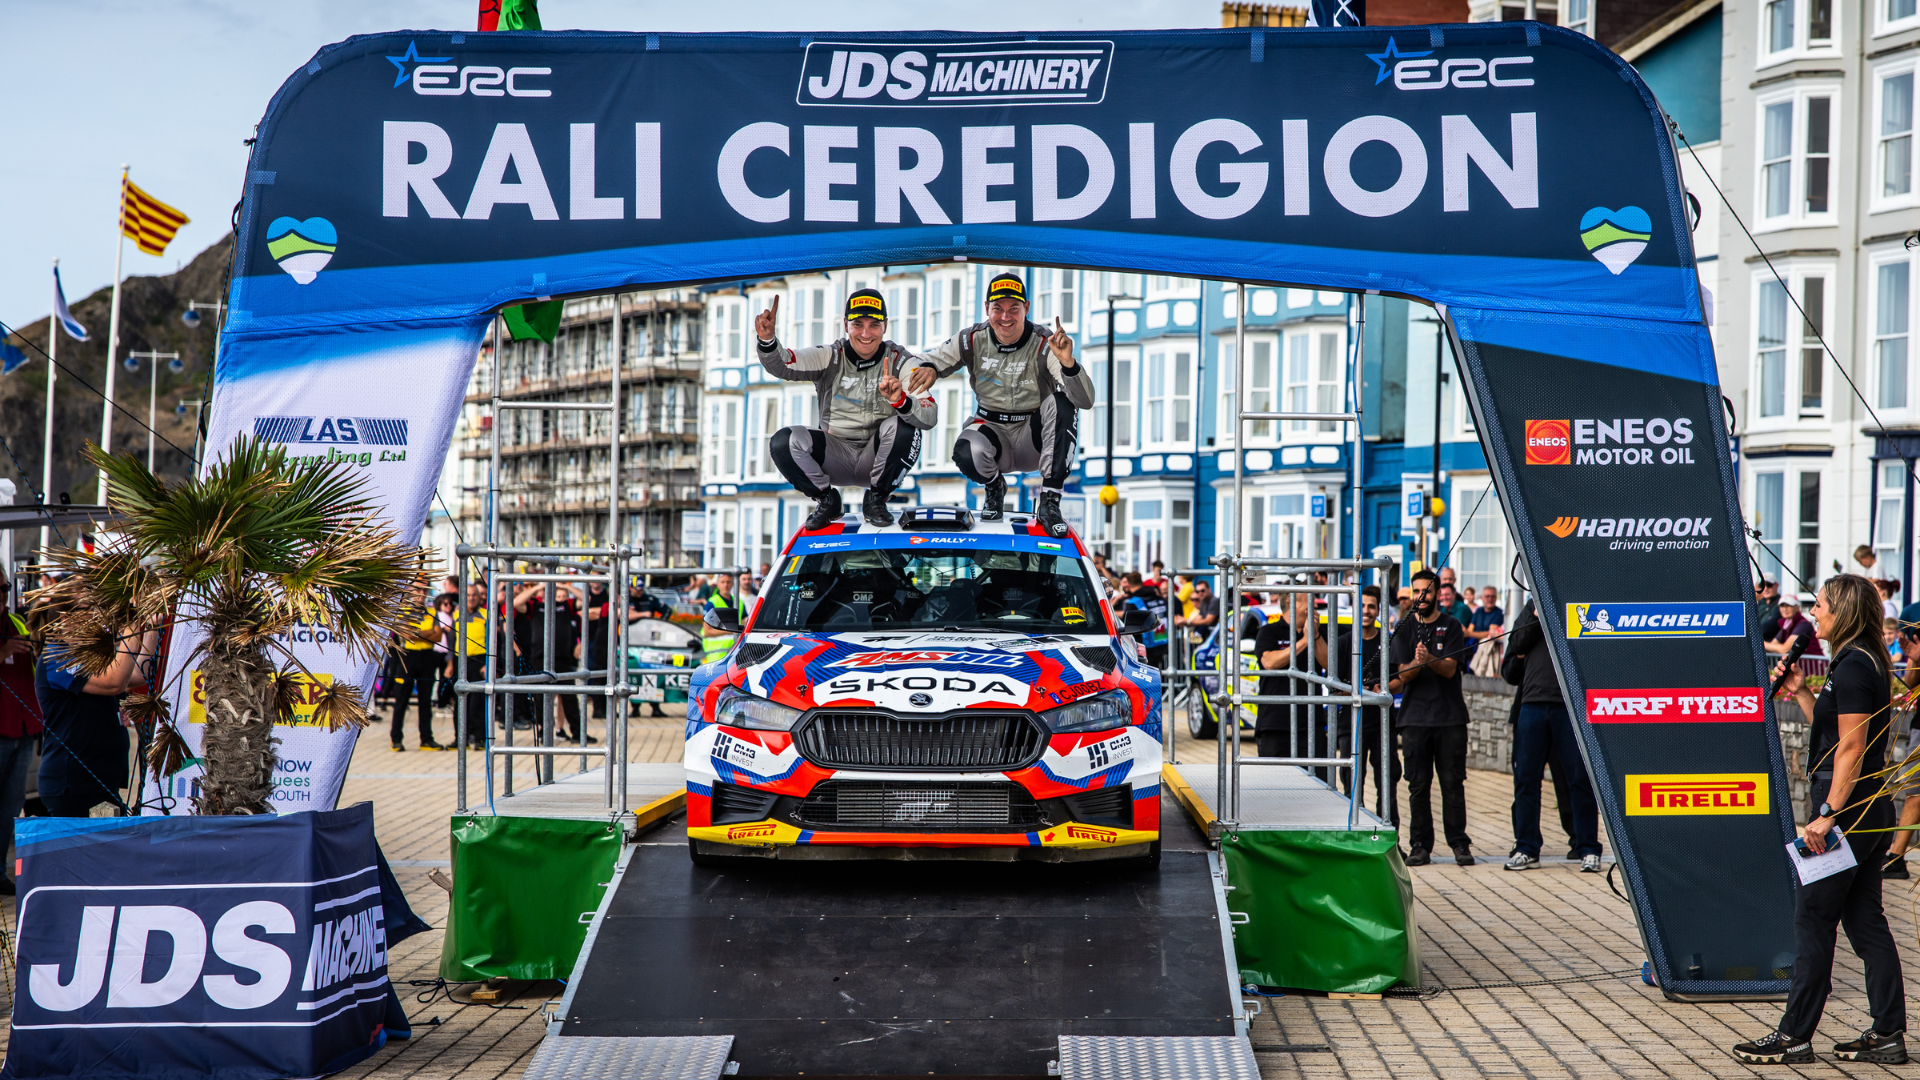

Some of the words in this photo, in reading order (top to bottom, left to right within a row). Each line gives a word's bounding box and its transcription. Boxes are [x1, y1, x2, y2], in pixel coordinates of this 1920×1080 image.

[413, 65, 552, 97] ERC
[808, 51, 928, 100] JDS
[929, 58, 1101, 93] MACHINERY
[1394, 56, 1535, 90] ERC
[382, 121, 661, 220] RALI
[717, 112, 1539, 225] CEREDIGION
[300, 418, 359, 442] LAS
[1574, 417, 1694, 445] ENEOS
[1528, 437, 1568, 447] ENEOS
[379, 450, 406, 462] Ltd
[1575, 448, 1654, 465] MOTOR
[1660, 447, 1695, 465] OIL
[1609, 538, 1653, 552] driving
[1656, 539, 1709, 550] emotion
[788, 556, 801, 574] 1
[853, 593, 874, 602] OMP
[1617, 614, 1730, 628] MICHELIN
[672, 654, 685, 667] 10
[830, 651, 1024, 668] AMSOIL
[665, 674, 690, 687] KE
[1060, 681, 1106, 700] CJ00BZ
[1592, 697, 1673, 715] MRF
[1678, 696, 1759, 715] TYRES
[733, 743, 756, 759] CM3
[1110, 735, 1132, 750] CM3
[731, 755, 754, 768] INVEST
[1112, 747, 1133, 760] INVEST
[1639, 782, 1757, 808] PIRELLI
[728, 824, 777, 840] PIRELLI
[1067, 826, 1118, 844] PIRELLI
[29, 900, 296, 1012] JDS
[301, 905, 388, 992] MACHINE
